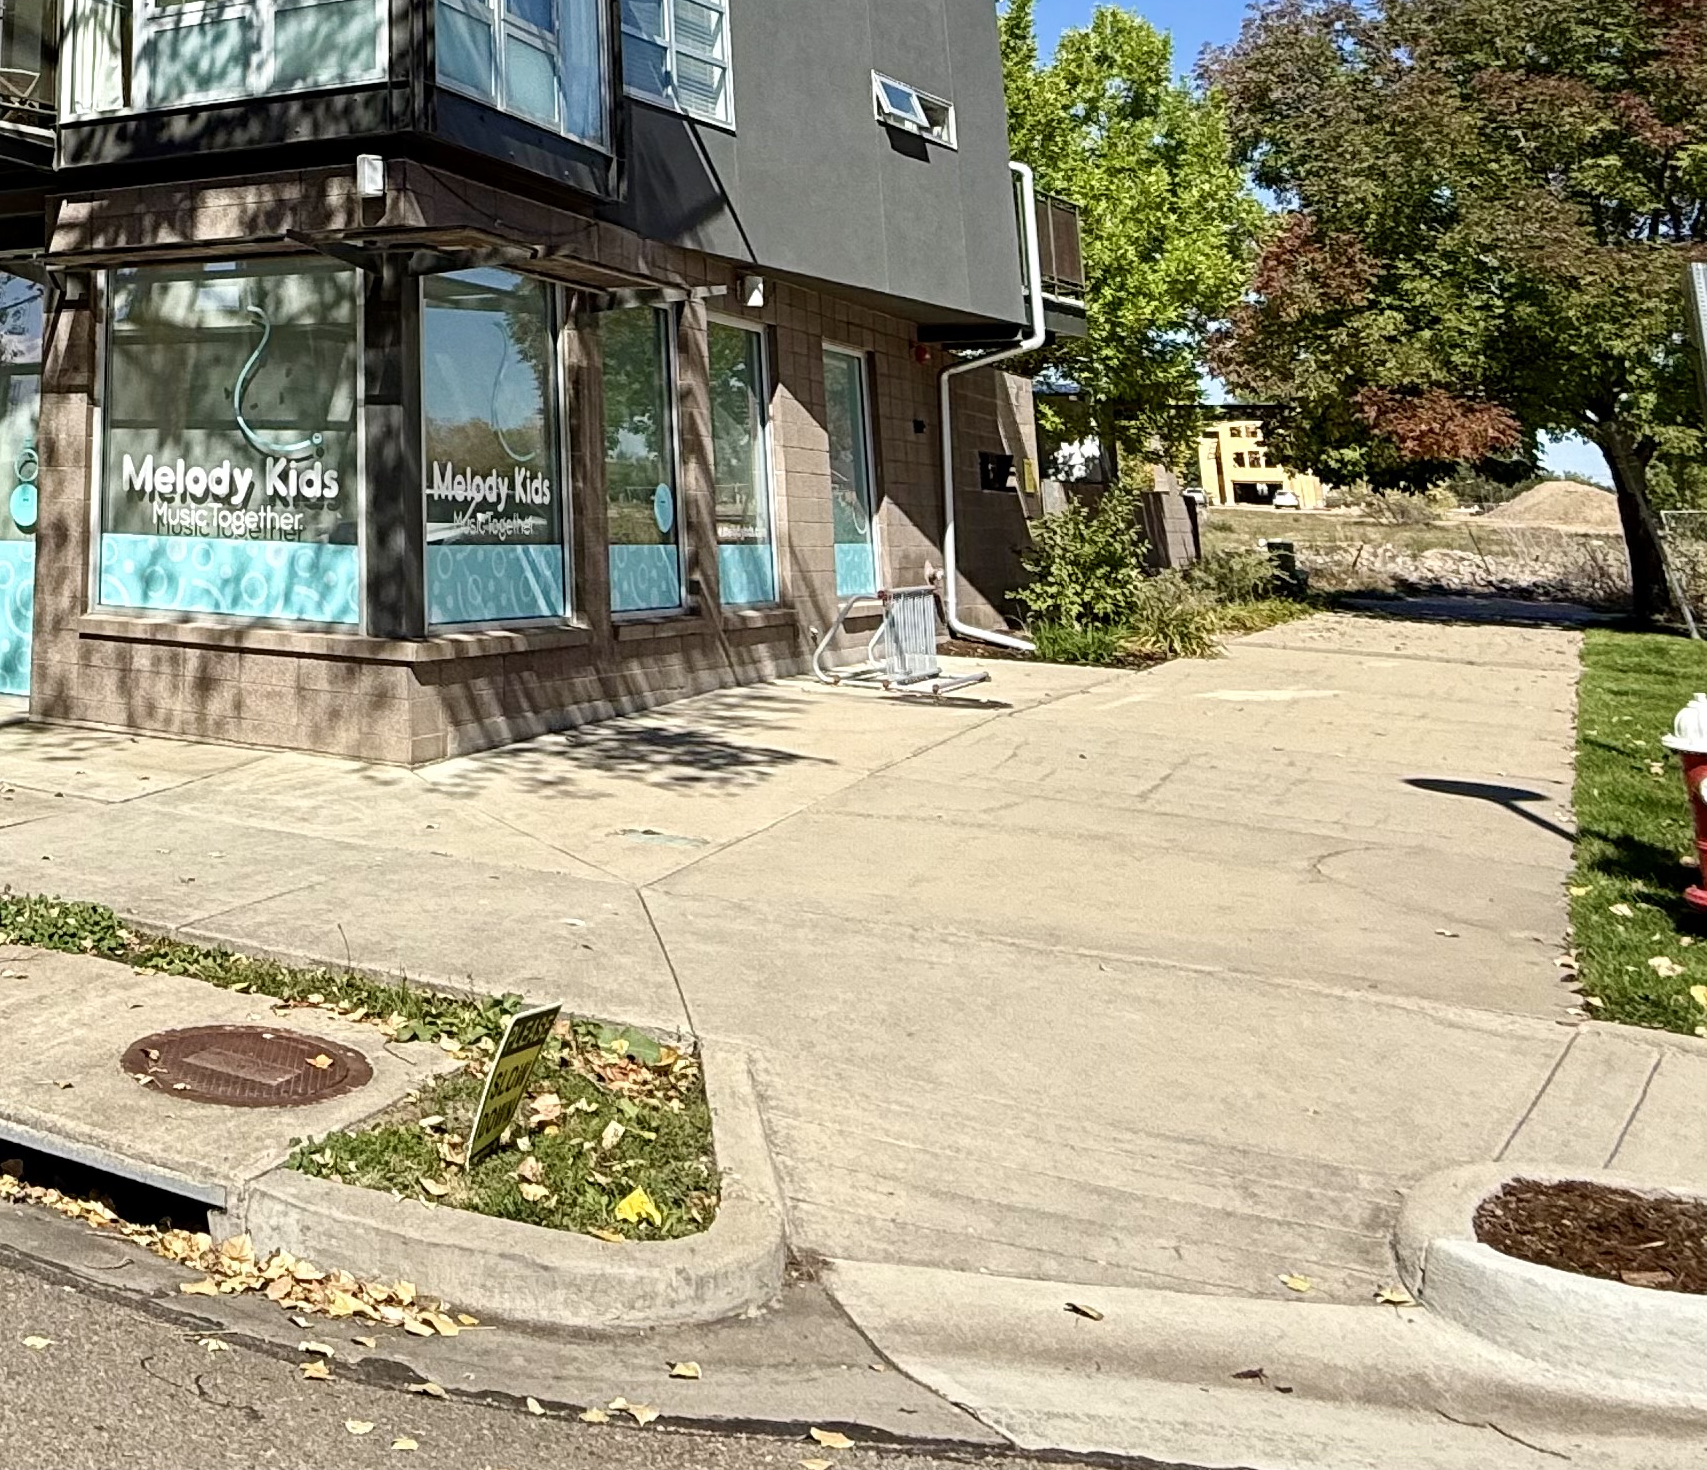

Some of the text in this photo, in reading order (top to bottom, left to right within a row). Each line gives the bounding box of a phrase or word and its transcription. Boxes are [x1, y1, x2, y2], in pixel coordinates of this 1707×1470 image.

[122, 453, 339, 505] Melody Kids
[433, 460, 551, 512] Melody Kids
[152, 500, 207, 527] Music
[454, 511, 486, 535] Music
[504, 1013, 555, 1053] PLEASE
[489, 1059, 533, 1100] SLOW
